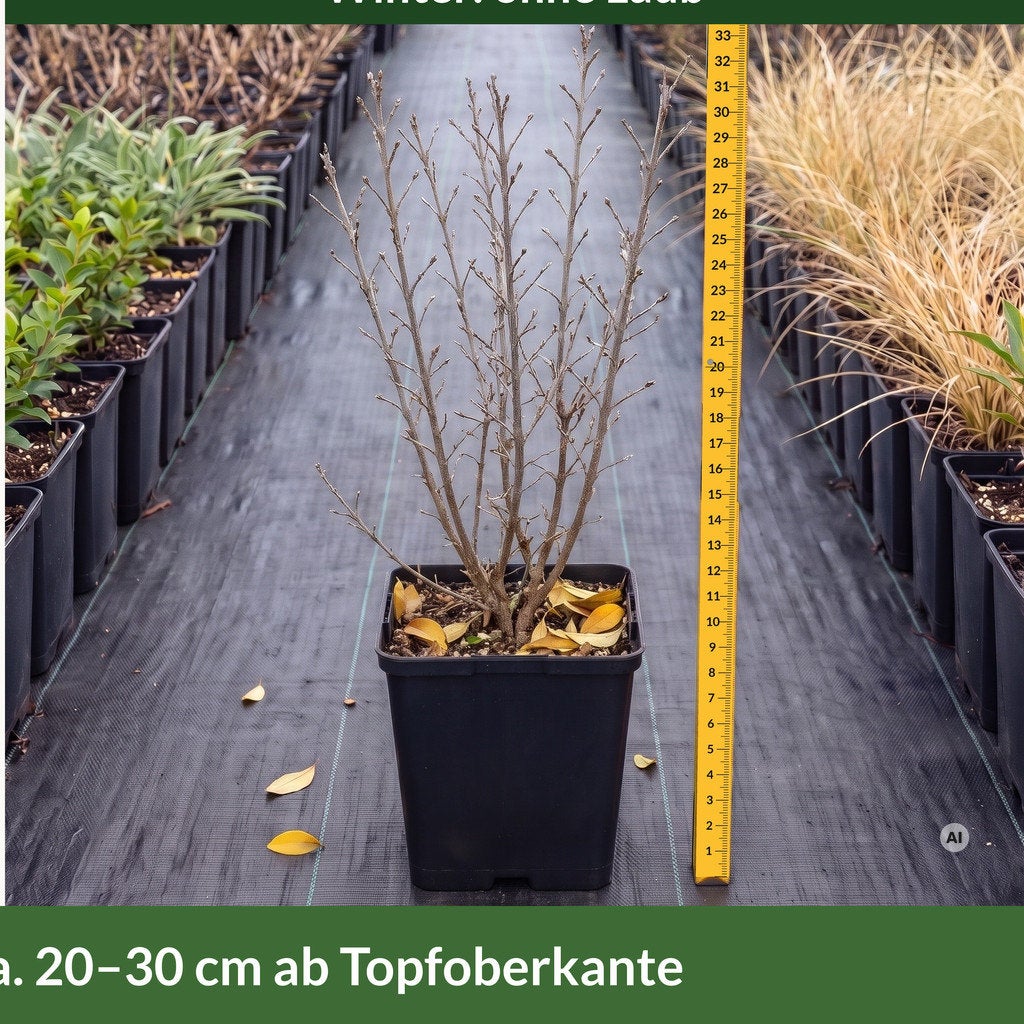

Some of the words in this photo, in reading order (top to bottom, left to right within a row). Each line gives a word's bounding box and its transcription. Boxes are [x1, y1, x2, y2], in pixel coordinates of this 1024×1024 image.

[715, 30, 731, 41] 33
[715, 55, 730, 67] 32
[714, 81, 729, 92] 31
[714, 106, 730, 118] 30
[713, 132, 729, 143] 29
[713, 157, 729, 168] 28
[712, 183, 728, 194] 27
[712, 208, 728, 219] 26
[712, 234, 727, 245] 25
[711, 259, 727, 271] 24
[711, 285, 726, 296] 23
[711, 310, 726, 321] 22
[710, 336, 724, 347] 21
[710, 361, 725, 372] 20
[710, 387, 724, 398] 19
[710, 412, 724, 423] 18
[710, 438, 723, 449] 17
[709, 463, 723, 474] 16
[709, 489, 722, 500] 15
[708, 515, 722, 525] 14
[708, 540, 721, 550] 13
[707, 565, 721, 576] 12
[707, 591, 720, 601] 11
[707, 616, 720, 627] 10
[709, 642, 716, 652] 9
[708, 667, 716, 678] 8
[708, 693, 715, 703] 7
[707, 718, 715, 729] 6
[707, 744, 714, 754] 5
[707, 770, 714, 779] 4
[706, 795, 713, 805] 3
[706, 820, 713, 831] 2
[706, 846, 712, 856] 1
